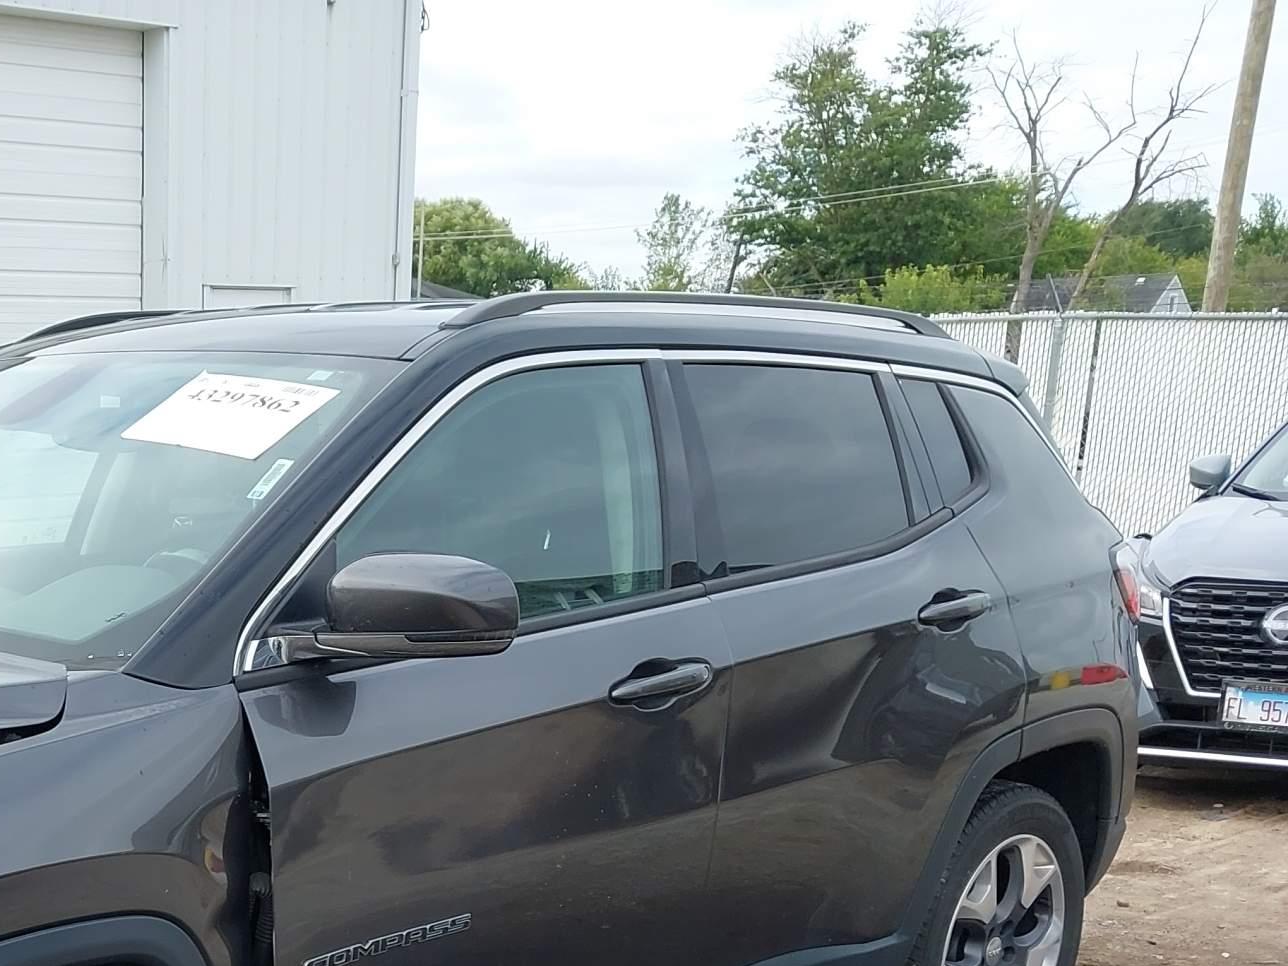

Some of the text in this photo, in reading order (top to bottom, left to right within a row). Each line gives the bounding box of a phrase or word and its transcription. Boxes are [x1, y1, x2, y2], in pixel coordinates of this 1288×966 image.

[188, 388, 301, 413] 43297862
[1226, 697, 1288, 724] FL 95
